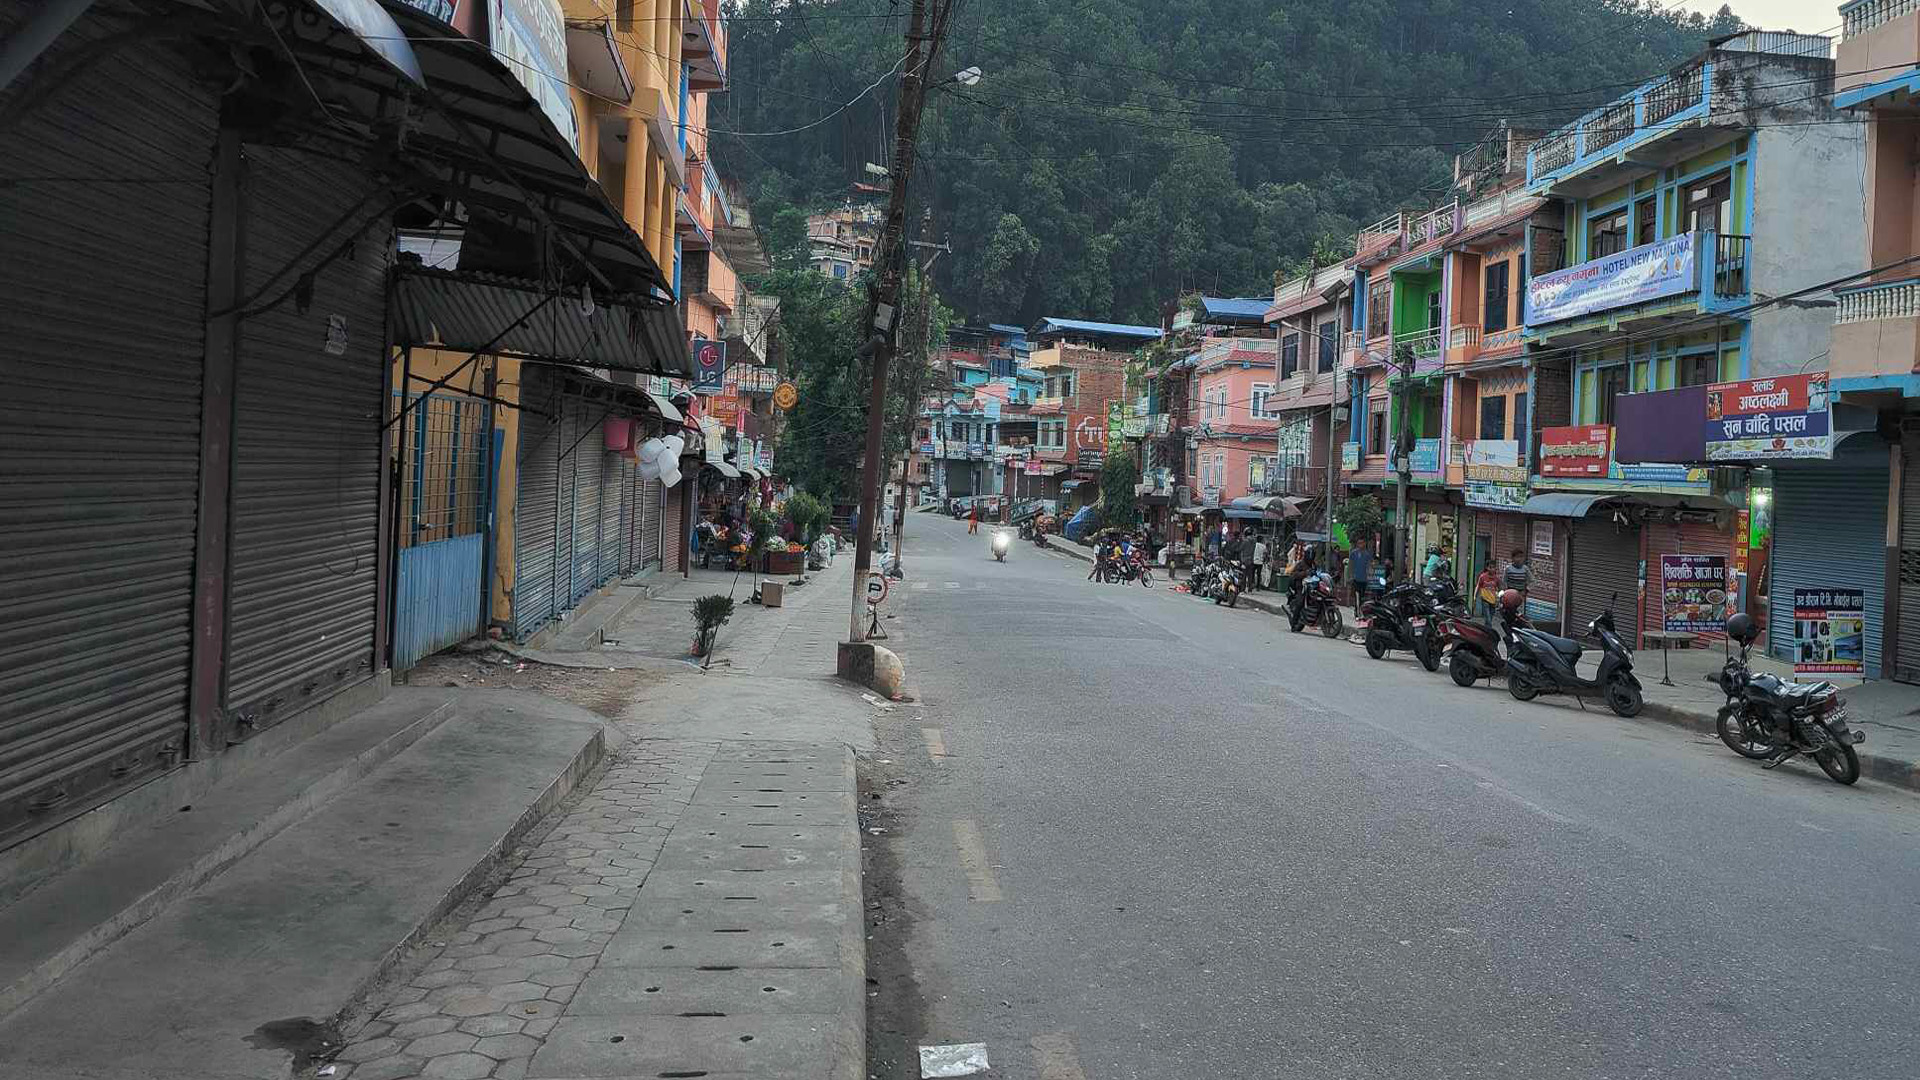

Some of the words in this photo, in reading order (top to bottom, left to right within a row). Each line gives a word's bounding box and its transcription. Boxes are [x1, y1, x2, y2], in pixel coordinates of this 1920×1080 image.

[1602, 258, 1630, 275] HOTEL
[1631, 251, 1651, 267] NEW
[700, 370, 717, 383] LG
[1723, 419, 1742, 439] सुन
[1774, 415, 1807, 433] पसल
[868, 583, 882, 593] P
